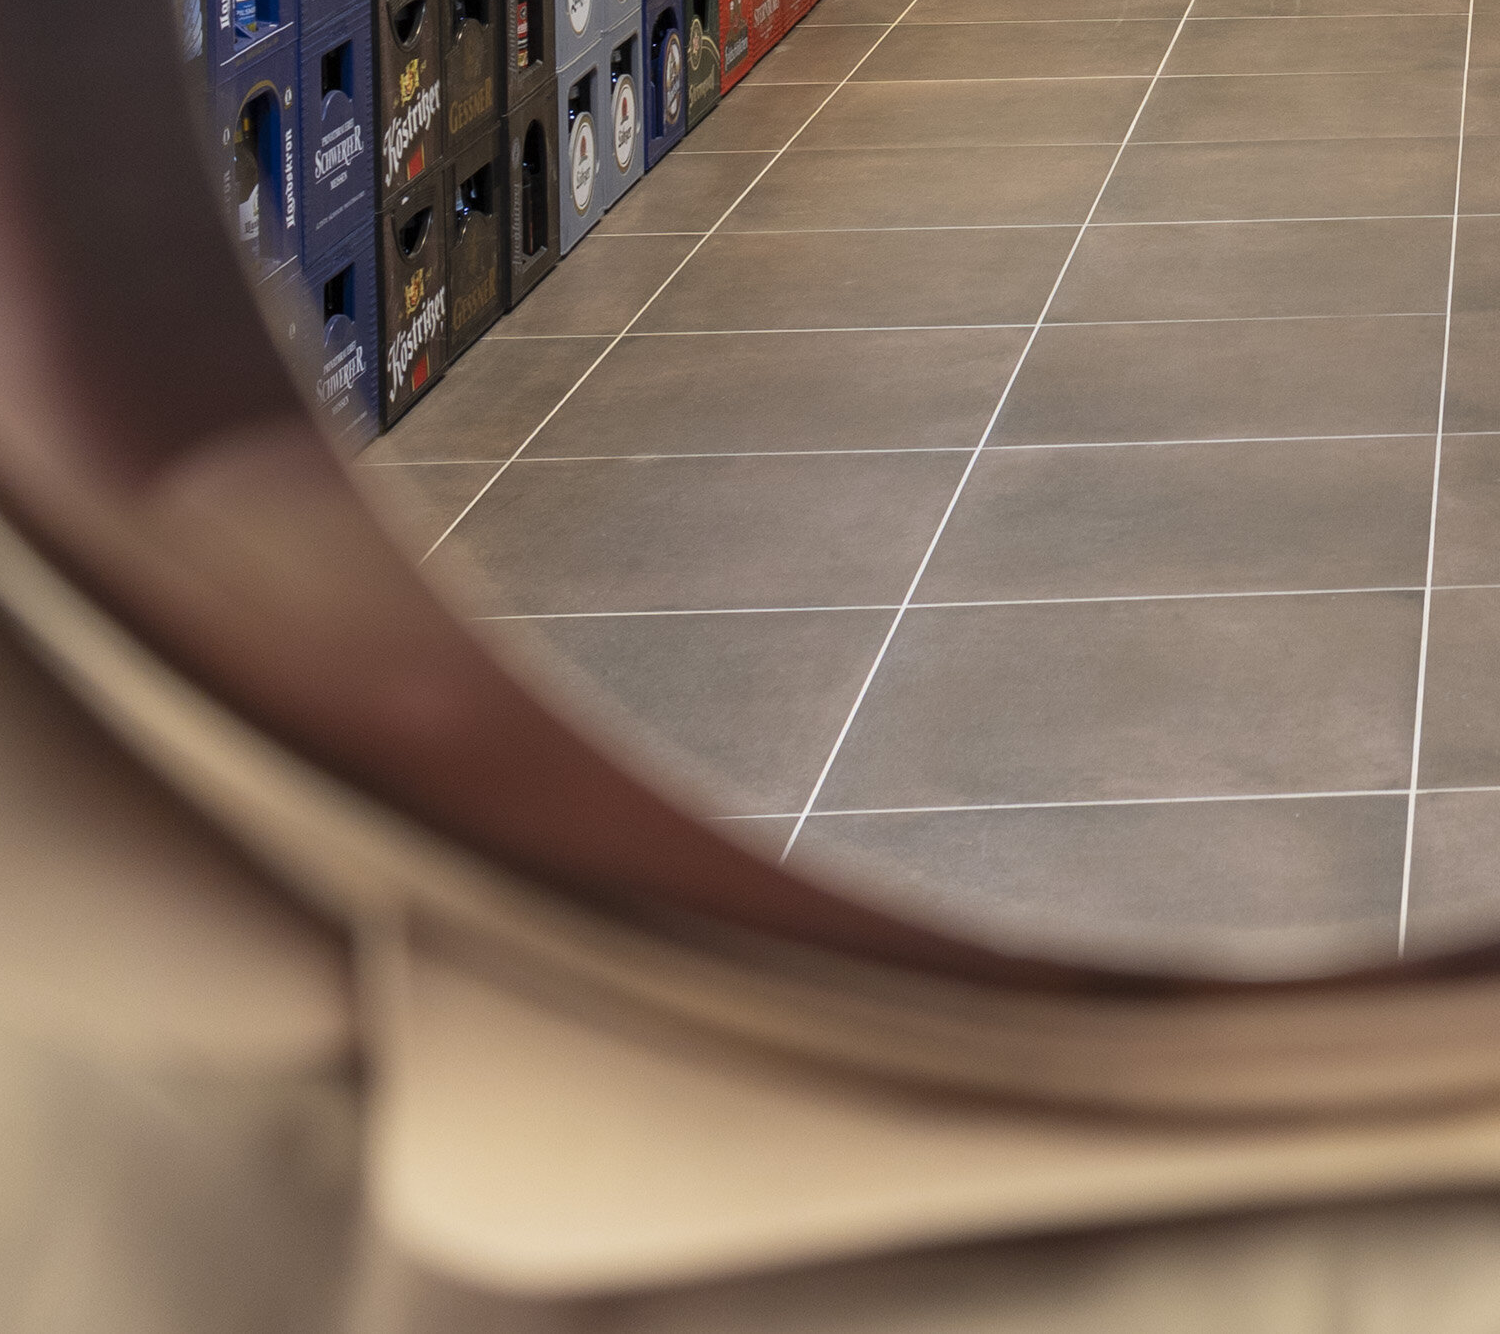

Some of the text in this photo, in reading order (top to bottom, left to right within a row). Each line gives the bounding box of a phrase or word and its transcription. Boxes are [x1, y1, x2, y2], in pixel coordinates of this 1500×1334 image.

[382, 79, 440, 187] Köstritzer
[448, 76, 493, 135] GESSNER
[285, 127, 296, 230] Landskron
[314, 124, 365, 180] SCHWERTER
[452, 275, 497, 331] GESSNER
[387, 285, 446, 403] Köstritzer
